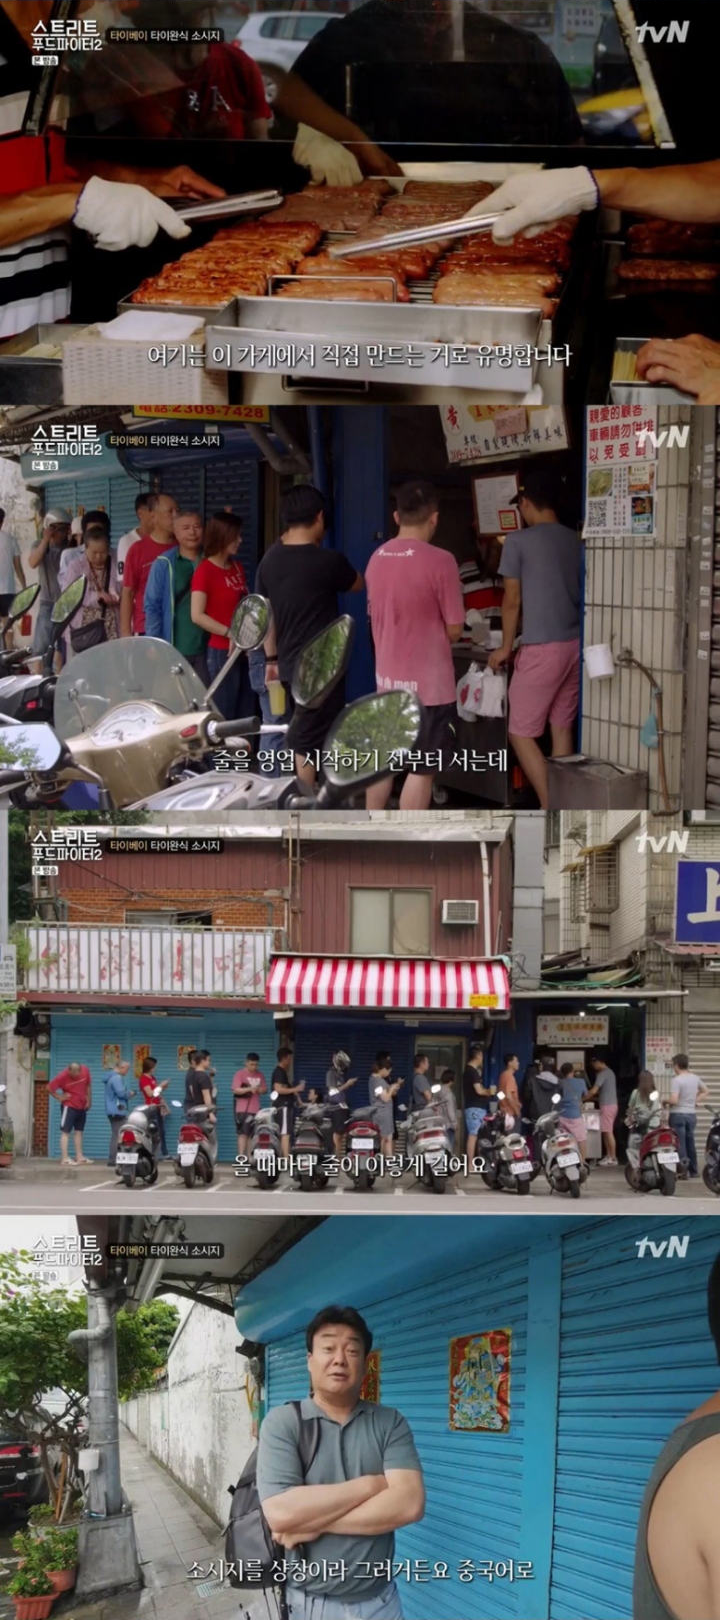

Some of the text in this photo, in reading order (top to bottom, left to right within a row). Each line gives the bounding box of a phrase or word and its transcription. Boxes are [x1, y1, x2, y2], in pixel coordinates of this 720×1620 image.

[447, 405, 460, 430] 黃
[589, 405, 642, 424] 親愛的顧客
